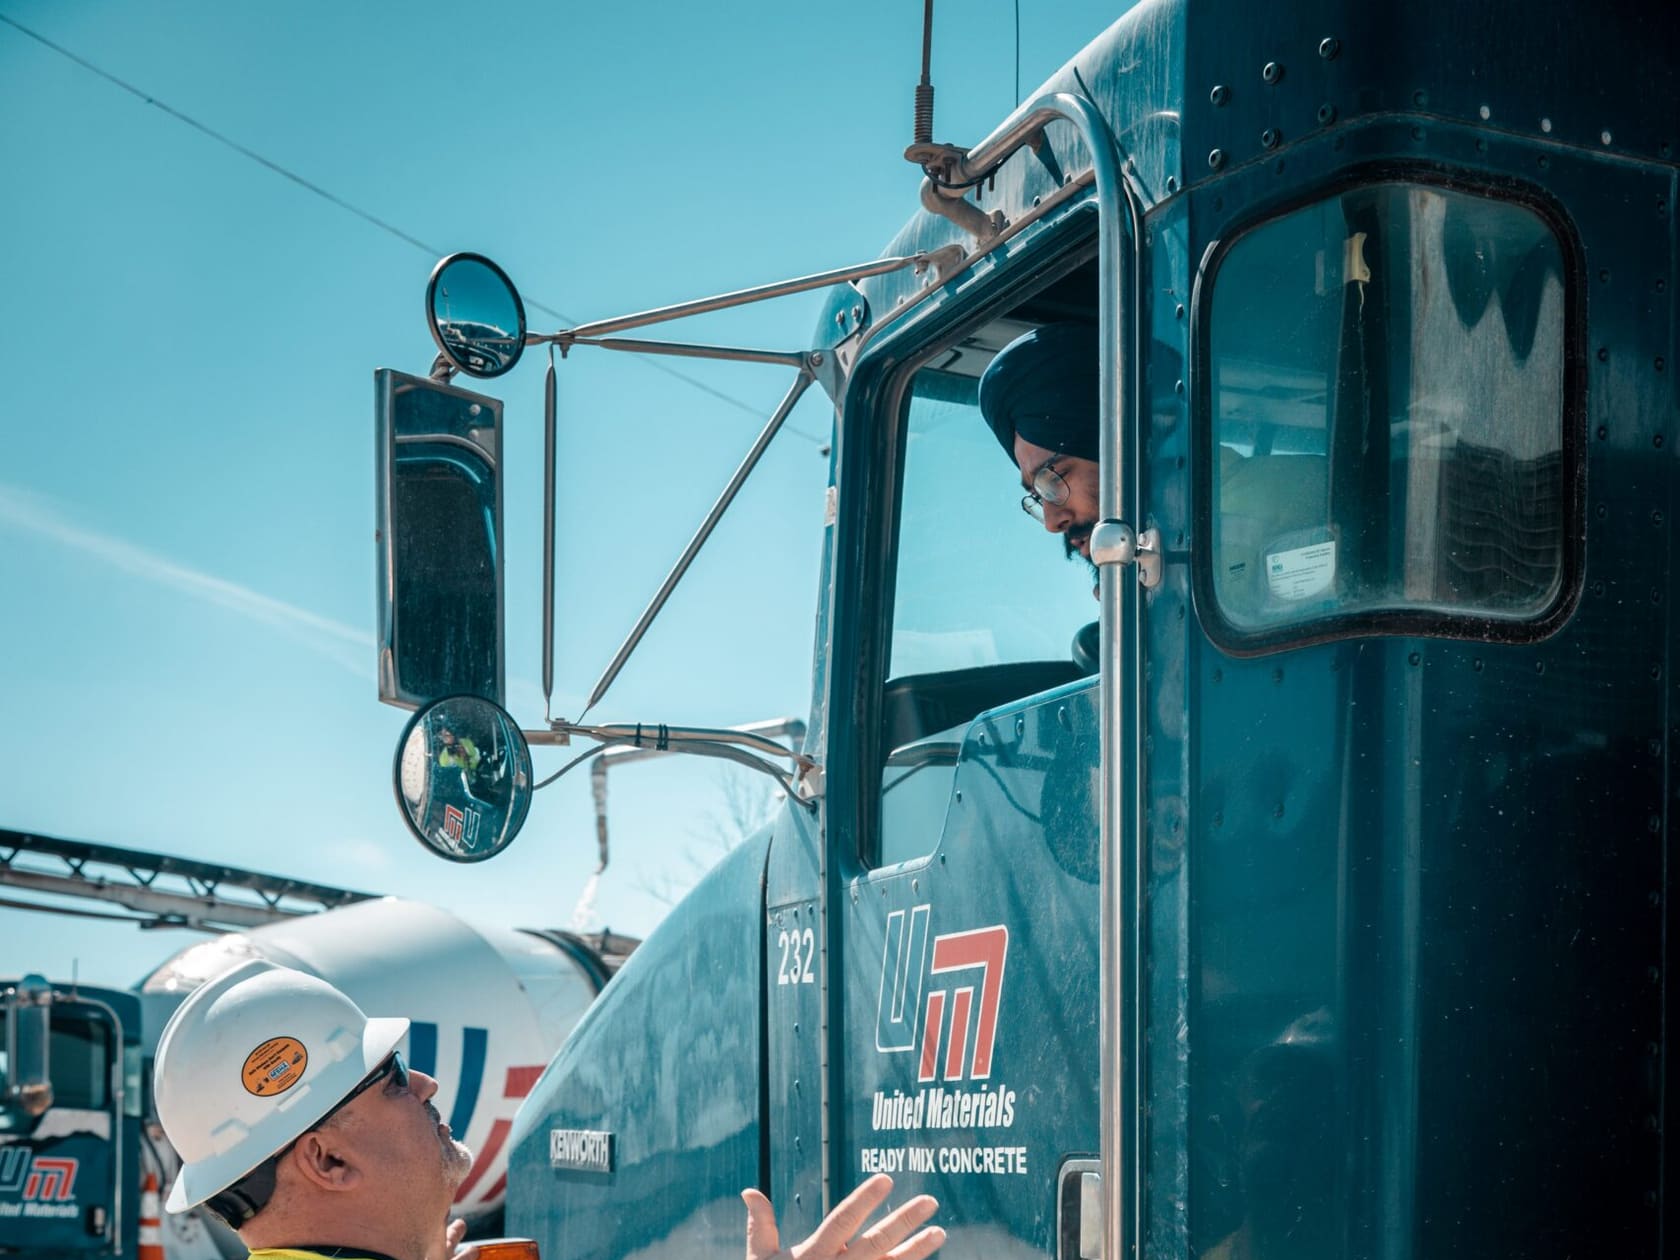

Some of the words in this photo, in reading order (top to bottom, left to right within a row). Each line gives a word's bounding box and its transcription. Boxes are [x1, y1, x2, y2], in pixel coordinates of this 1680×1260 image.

[777, 928, 814, 984] 232
[872, 1089, 926, 1131] United
[926, 1084, 1016, 1129] Materials
[550, 1131, 609, 1165] KENWORTH
[862, 1148, 906, 1173] READY
[908, 1147, 936, 1173] MIX
[939, 1147, 1028, 1174] CONCRETE
